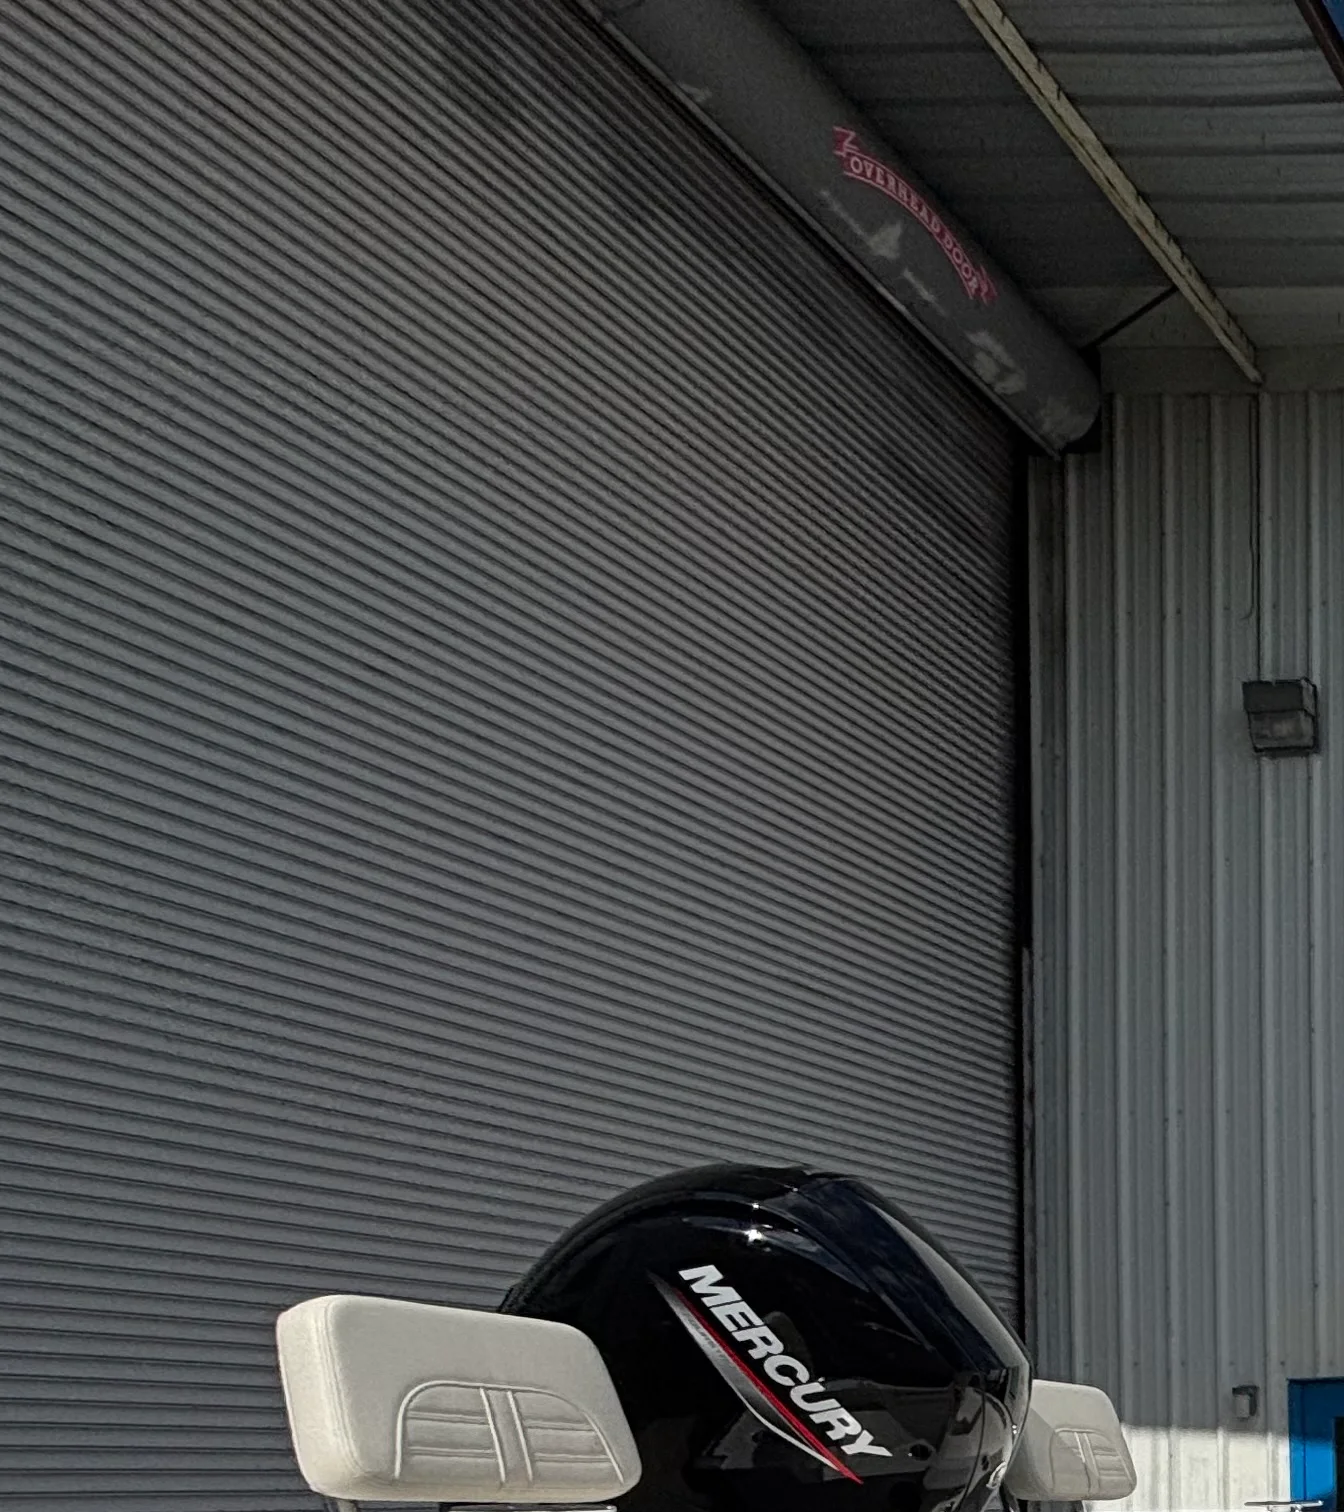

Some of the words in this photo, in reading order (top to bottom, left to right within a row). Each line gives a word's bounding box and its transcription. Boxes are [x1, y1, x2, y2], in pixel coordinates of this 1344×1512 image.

[849, 156, 942, 233] OVERHEAD
[943, 236, 980, 295] DOOR
[678, 1264, 893, 1458] MERCURY
